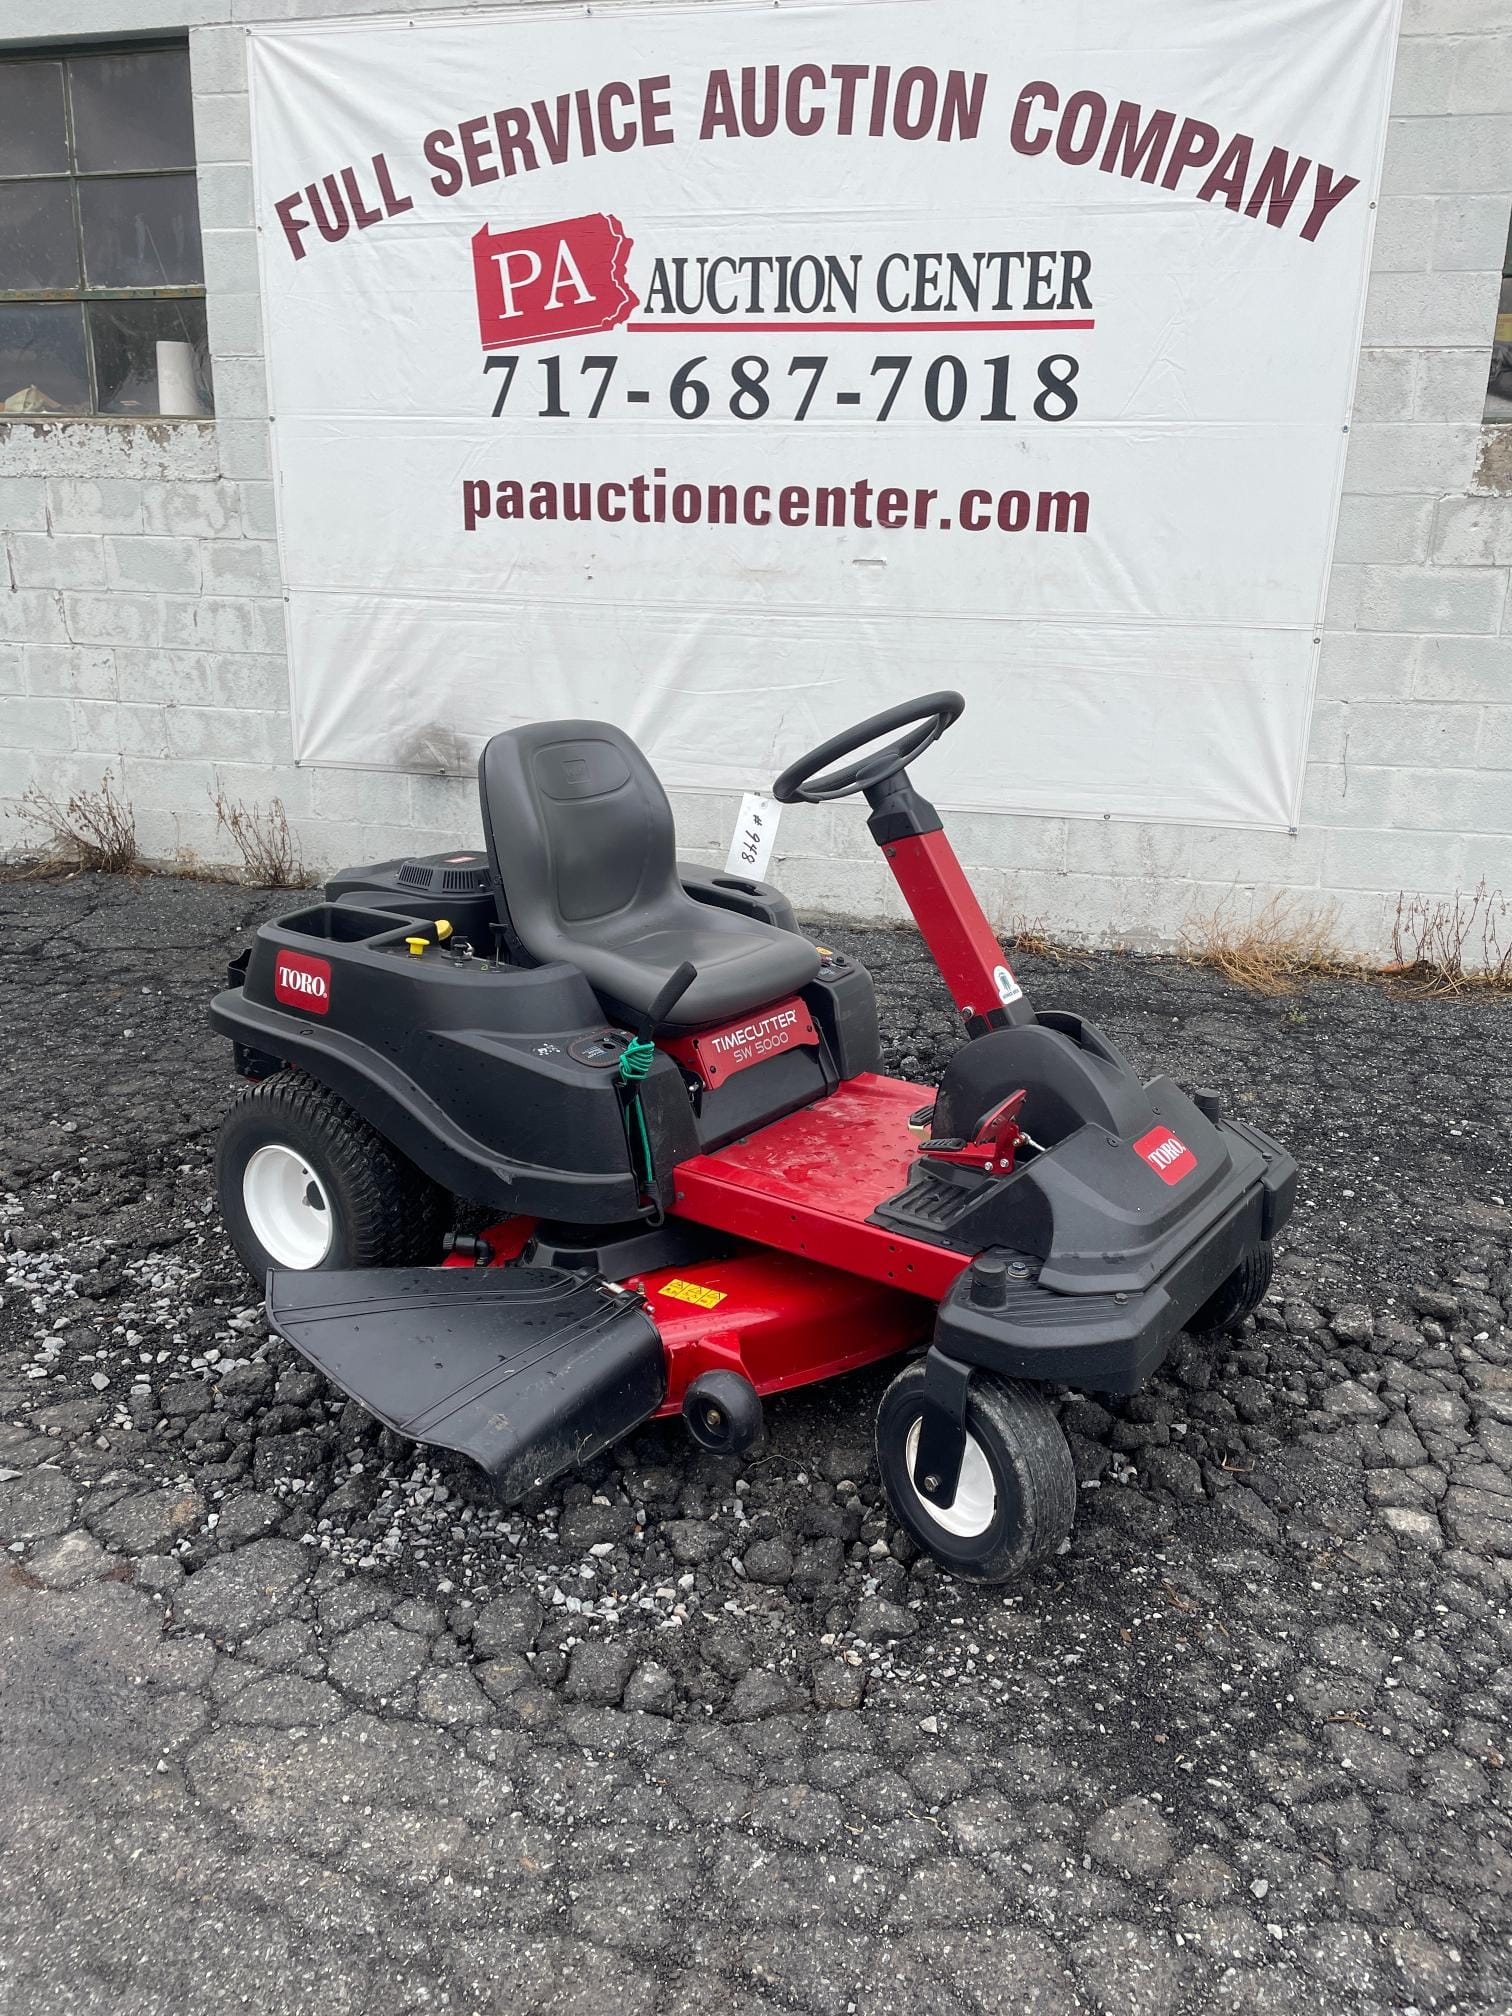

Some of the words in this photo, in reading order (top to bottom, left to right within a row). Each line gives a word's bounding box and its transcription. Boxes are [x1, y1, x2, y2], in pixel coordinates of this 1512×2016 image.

[274, 153, 414, 260] FULL
[424, 75, 674, 198] SERVICE
[700, 64, 988, 143] AUCTION
[1010, 81, 1360, 243] COMPANY
[490, 239, 597, 320] PA
[644, 255, 863, 315] AUCTION
[876, 250, 1093, 313] CENTER
[483, 354, 1080, 422] 717-687-7018
[463, 468, 1090, 534] paauctioncenter.com
[712, 1010, 798, 1053] TIMECUTTER
[733, 1045, 753, 1063] SW
[755, 1032, 789, 1054] 5000
